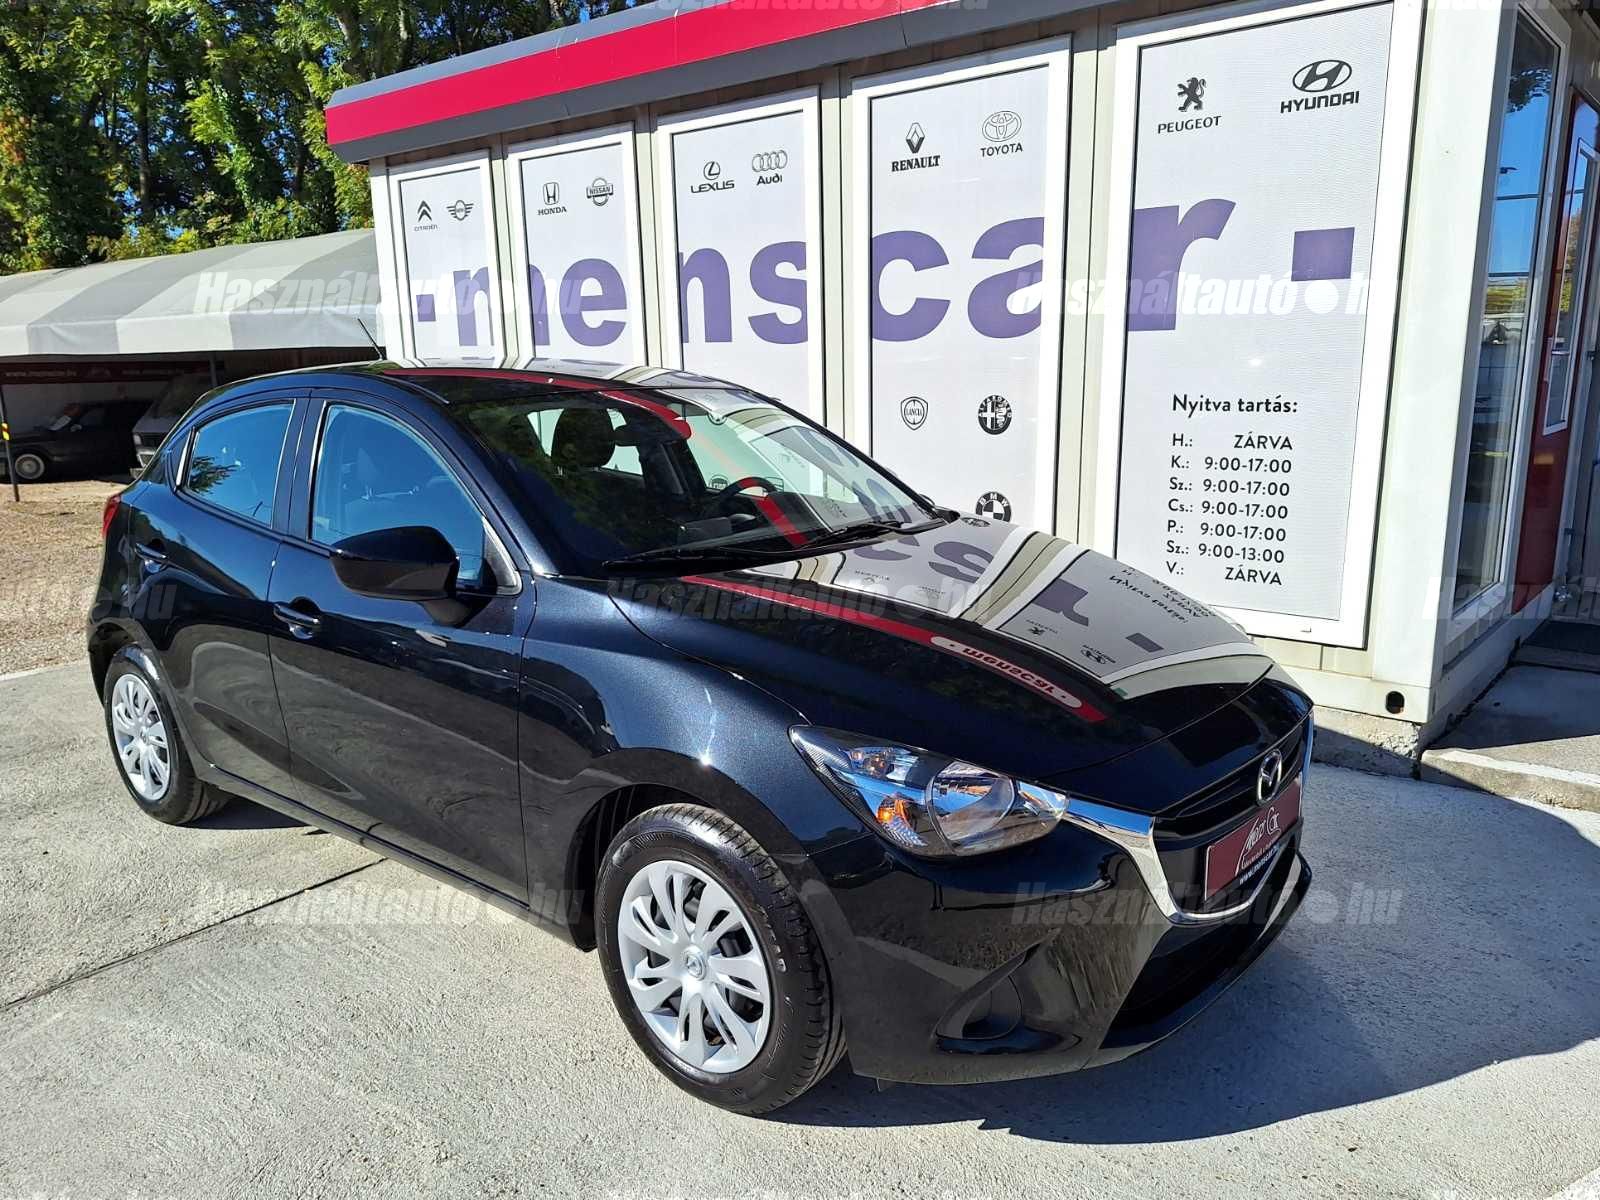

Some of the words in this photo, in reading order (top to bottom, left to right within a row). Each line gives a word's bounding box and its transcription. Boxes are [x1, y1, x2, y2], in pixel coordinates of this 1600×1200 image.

[1280, 91, 1360, 113] HYUNDAI
[1157, 115, 1222, 134] PEUGEOT
[980, 142, 1023, 157] TOYOTA
[891, 155, 940, 172] RENAULT
[690, 179, 735, 193] LEXUS
[756, 173, 783, 186] Audi
[589, 186, 611, 195] NISSAN
[538, 206, 567, 216] HONDA
[1172, 394, 1231, 418] Nyitva
[1238, 395, 1298, 413] tartás:
[1172, 433, 1193, 447] H.:
[1233, 431, 1293, 450] ZÁRVA
[1171, 455, 1190, 469] K.:
[1204, 456, 1292, 473] 9:00-17:00
[1169, 477, 1192, 491] Sz.:
[1203, 479, 1290, 496] 9:00-17:00
[1168, 499, 1193, 513] Cs.:
[1201, 500, 1288, 519] 9:00-17:00
[1167, 520, 1184, 533] P.:
[1200, 522, 1286, 542] 9:00-17:00
[1166, 540, 1189, 554] Sz.:
[1198, 543, 1285, 563] 9:00-13:00
[1166, 561, 1184, 575] V.:
[1225, 564, 1282, 586] ZÁRVA
